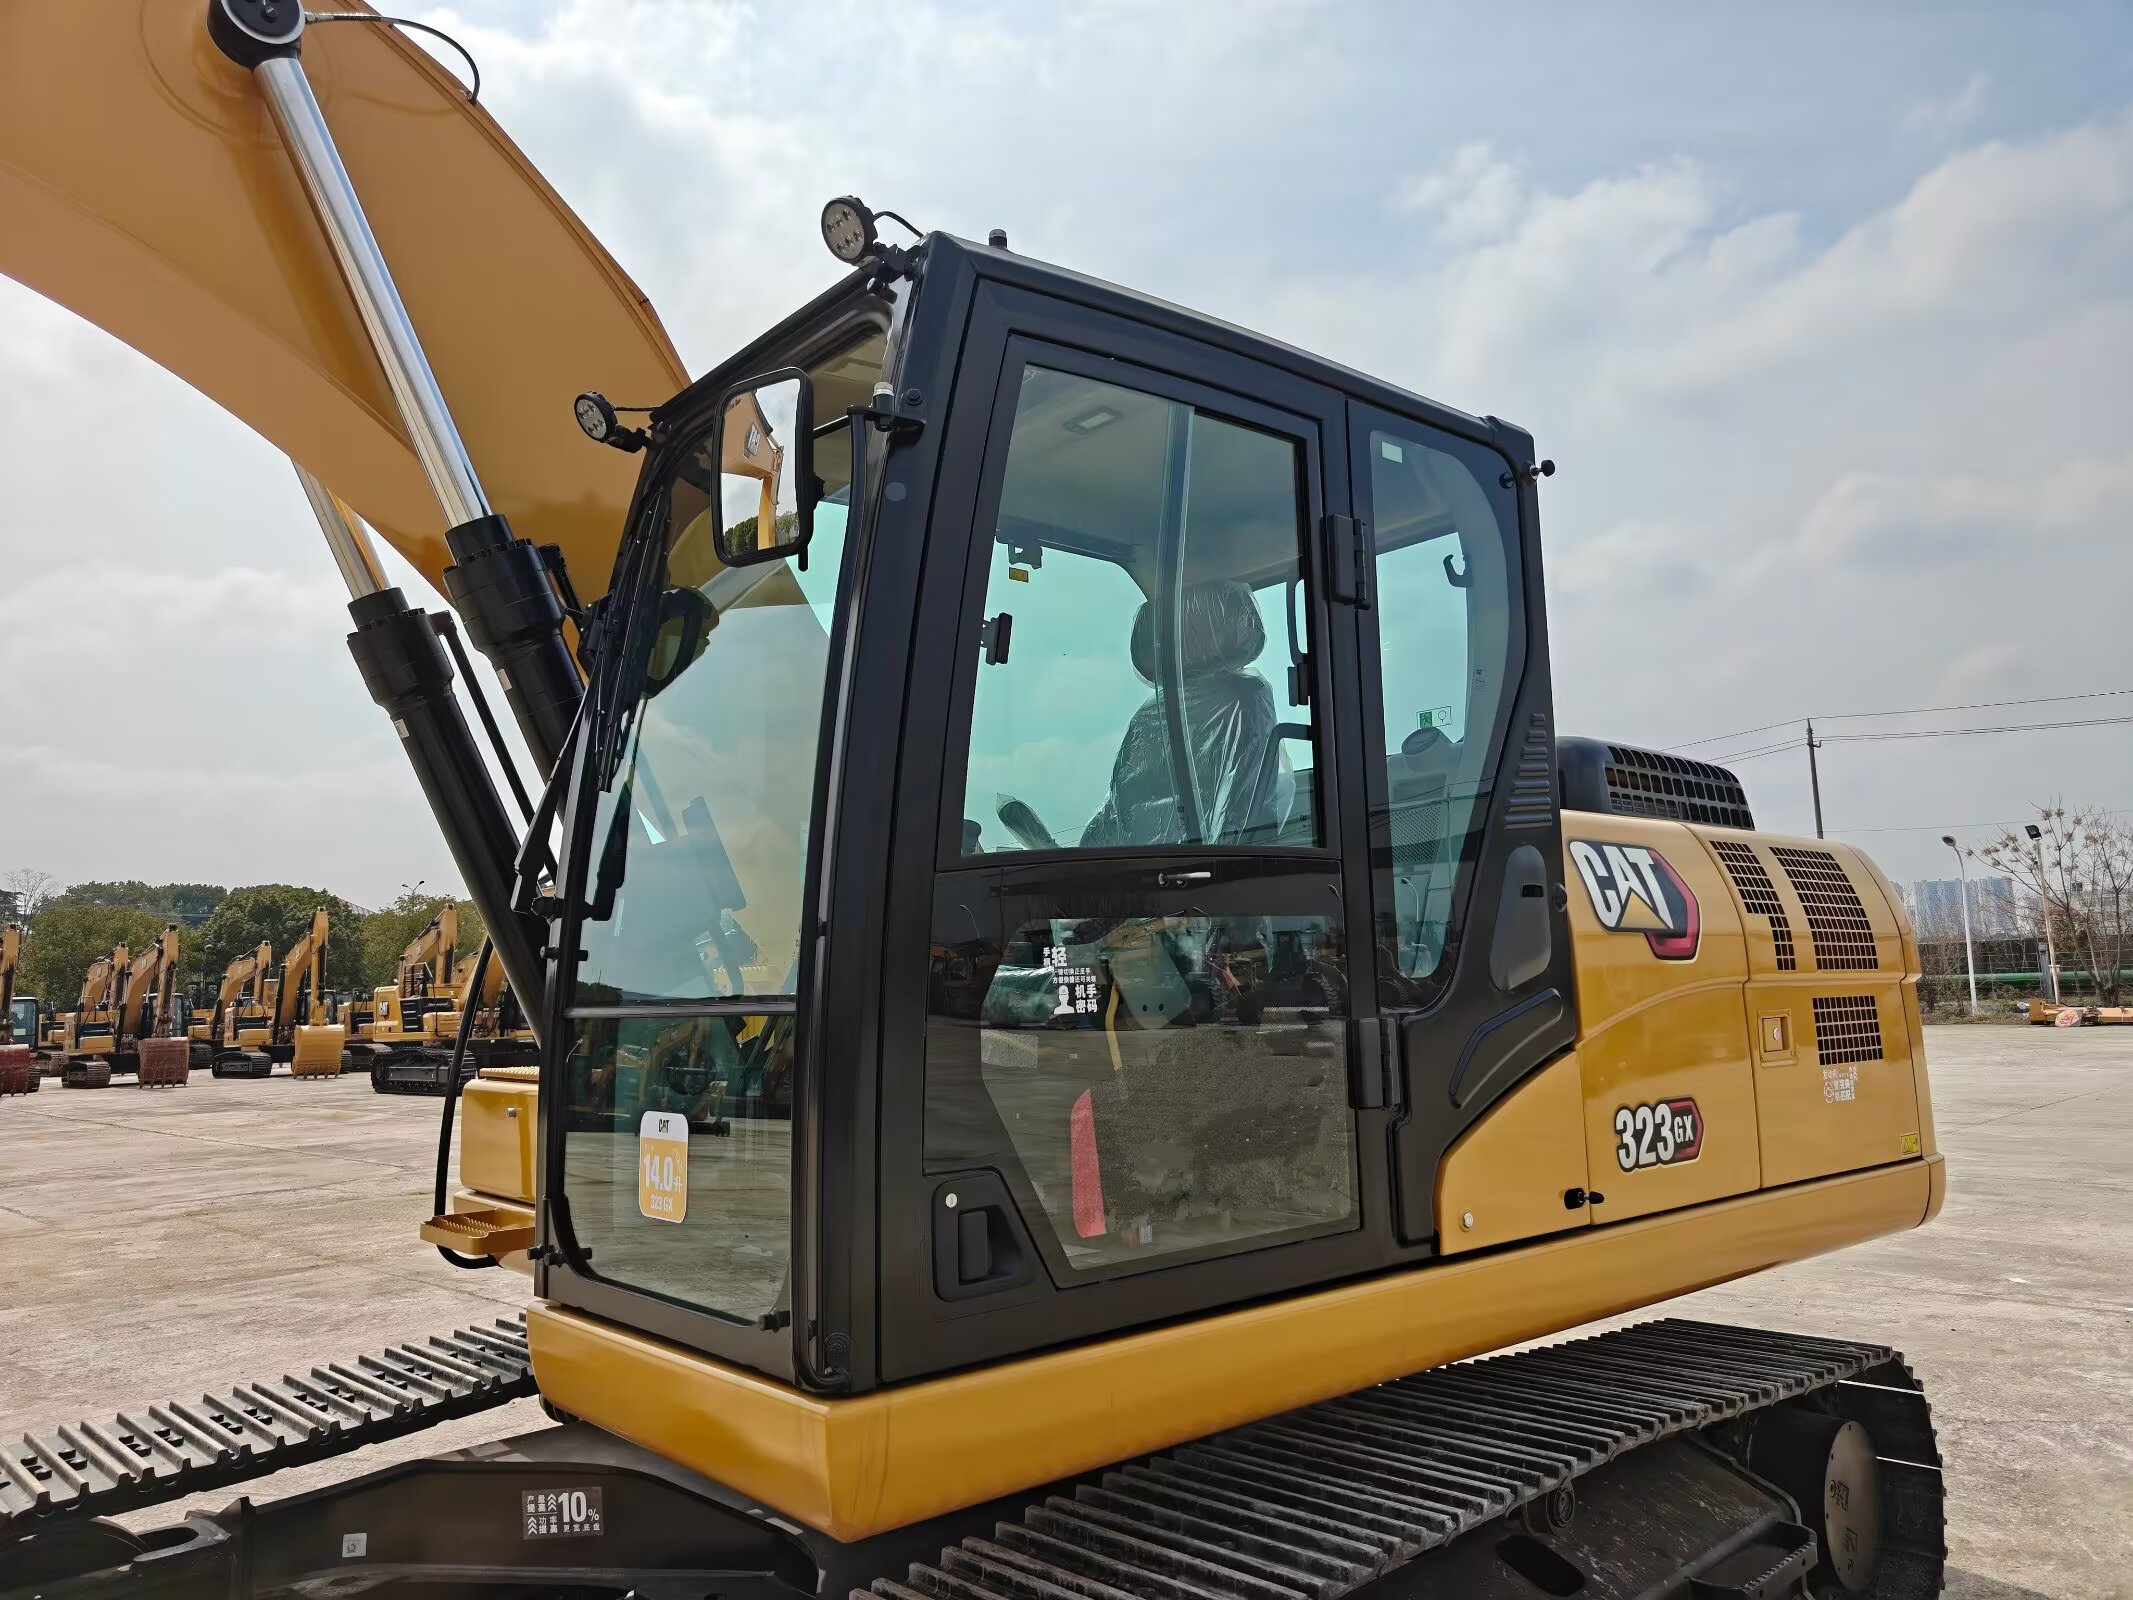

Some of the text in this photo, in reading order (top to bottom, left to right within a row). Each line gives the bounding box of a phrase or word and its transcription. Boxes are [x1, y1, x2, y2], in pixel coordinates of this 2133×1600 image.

[1568, 841, 1674, 929] CAT
[1075, 984, 1097, 998] 机手
[1075, 999, 1097, 1013] 密码
[658, 1119, 670, 1134] CAT
[1615, 1103, 1694, 1169] 323 GX
